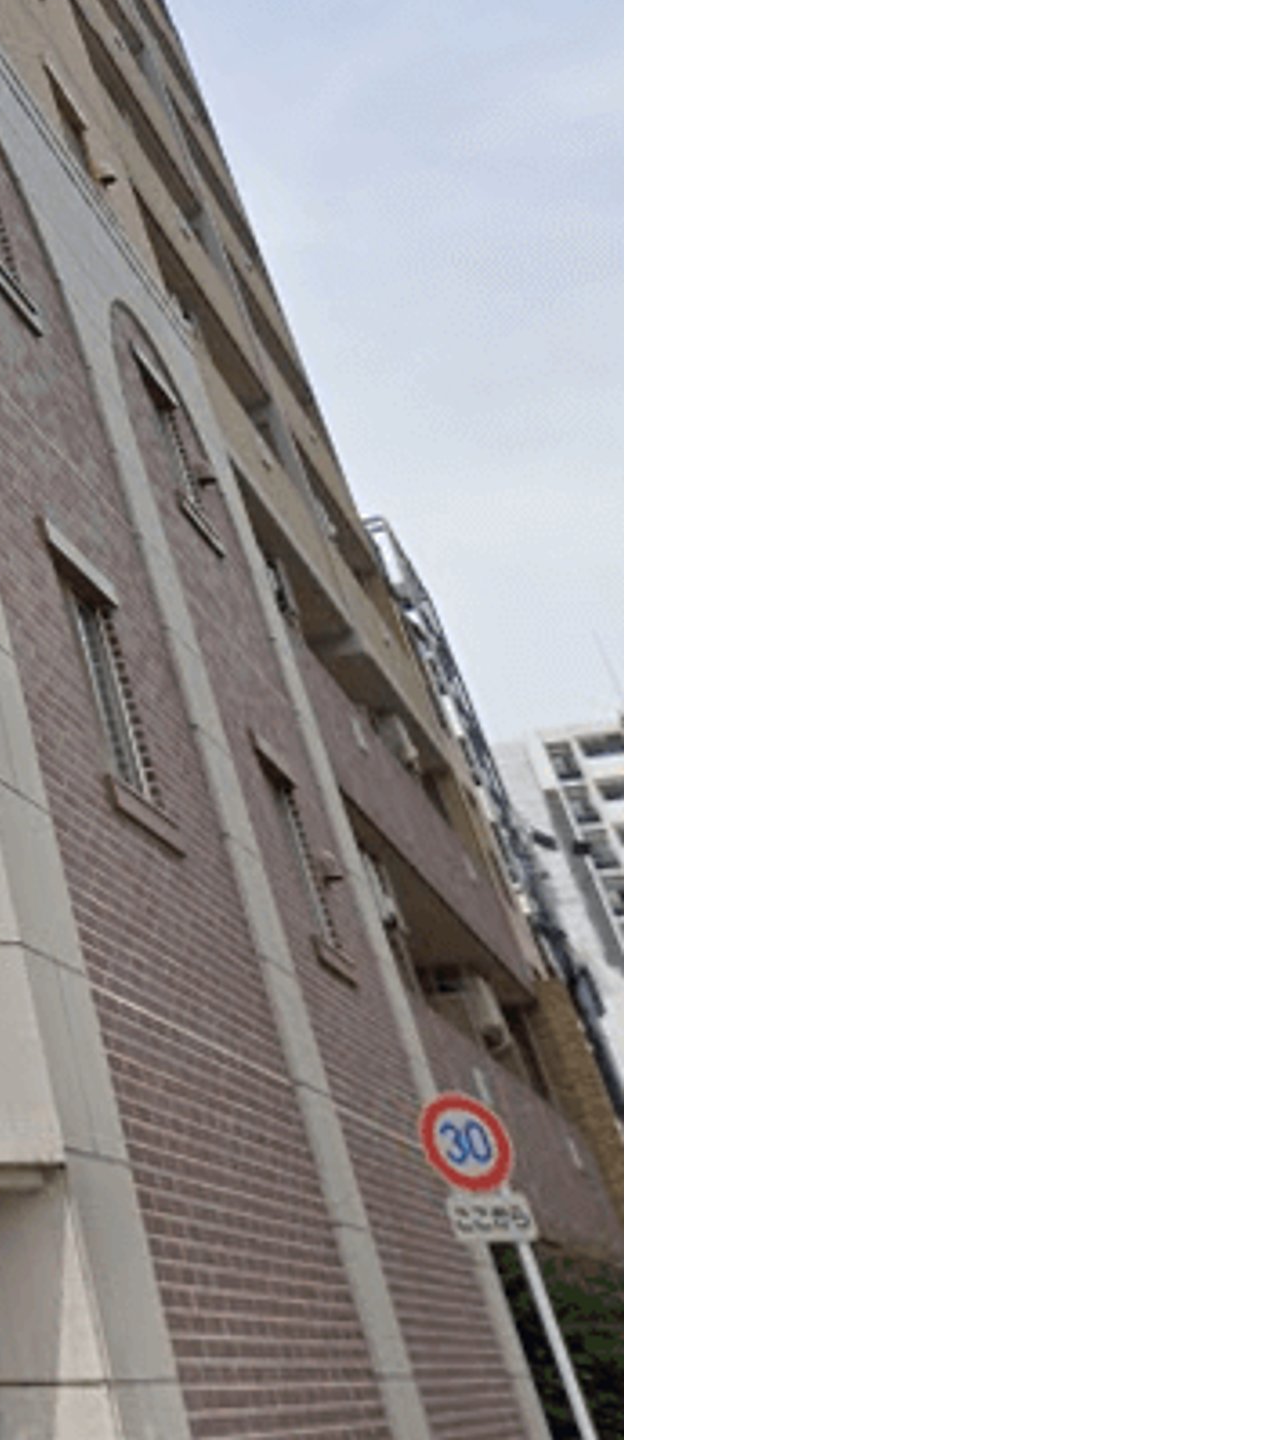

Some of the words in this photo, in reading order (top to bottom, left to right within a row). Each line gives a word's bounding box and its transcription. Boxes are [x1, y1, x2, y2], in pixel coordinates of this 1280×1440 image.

[439, 1119, 492, 1164] 30
[454, 1205, 531, 1232] ここから
